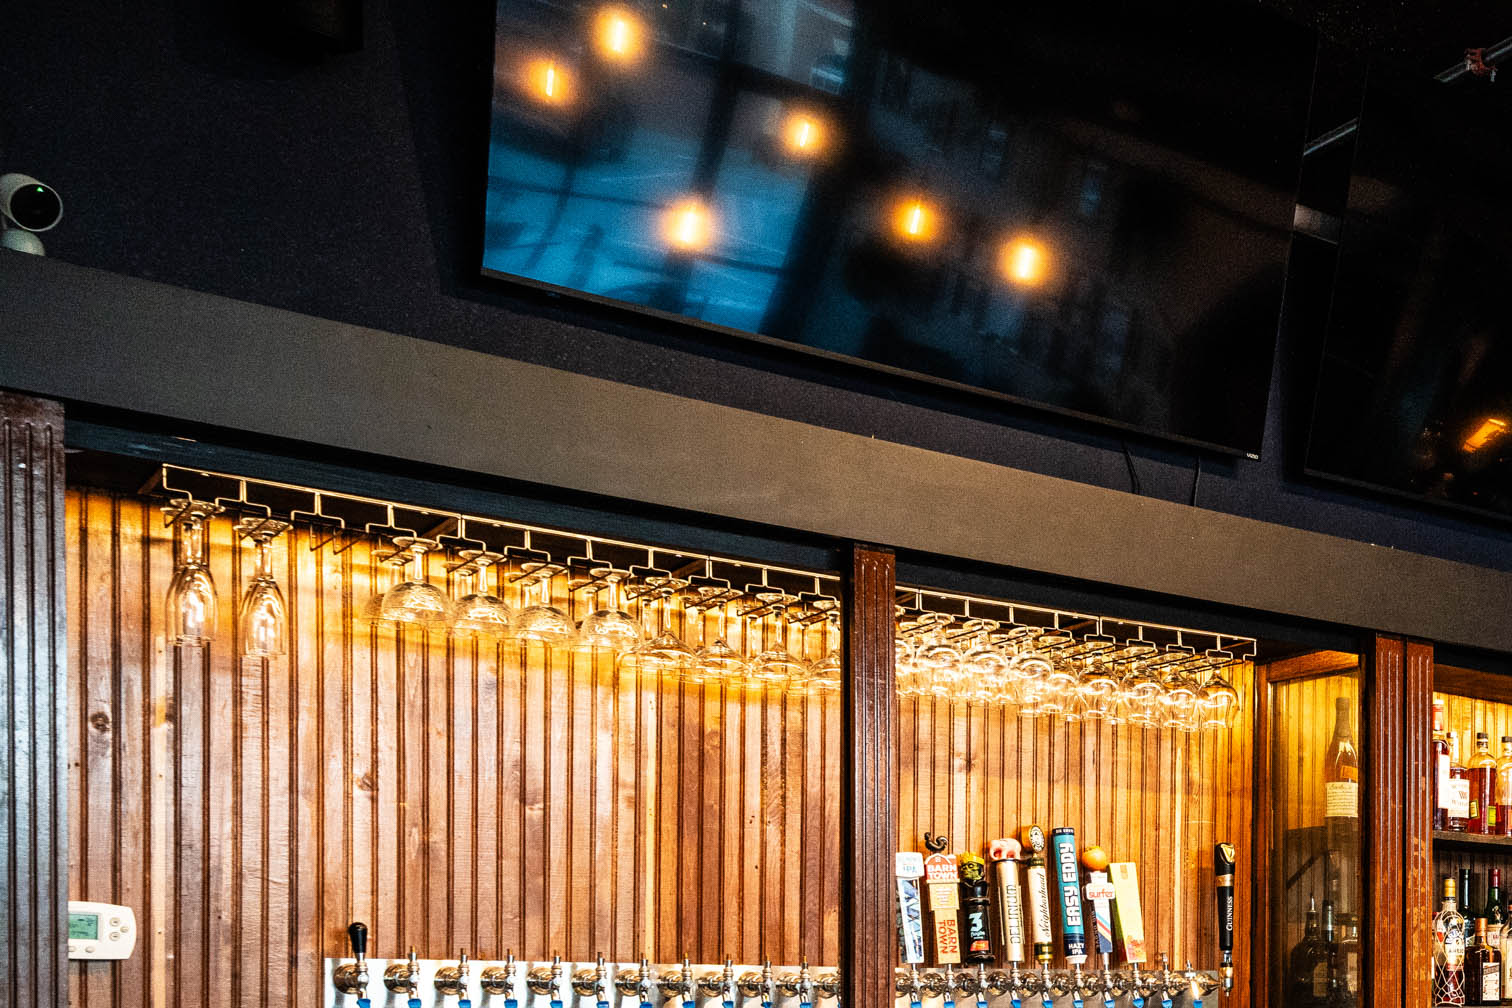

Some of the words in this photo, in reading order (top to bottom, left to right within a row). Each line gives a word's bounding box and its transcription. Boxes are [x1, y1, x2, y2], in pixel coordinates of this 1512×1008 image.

[927, 864, 957, 872] BARN
[928, 872, 958, 880] TOWN
[1060, 842, 1077, 883] EDDY
[968, 912, 983, 932] 3
[1063, 885, 1081, 926] EASY
[1225, 896, 1233, 931] GUINNESS
[937, 919, 949, 954] TOWN
[946, 919, 958, 954] BARN
